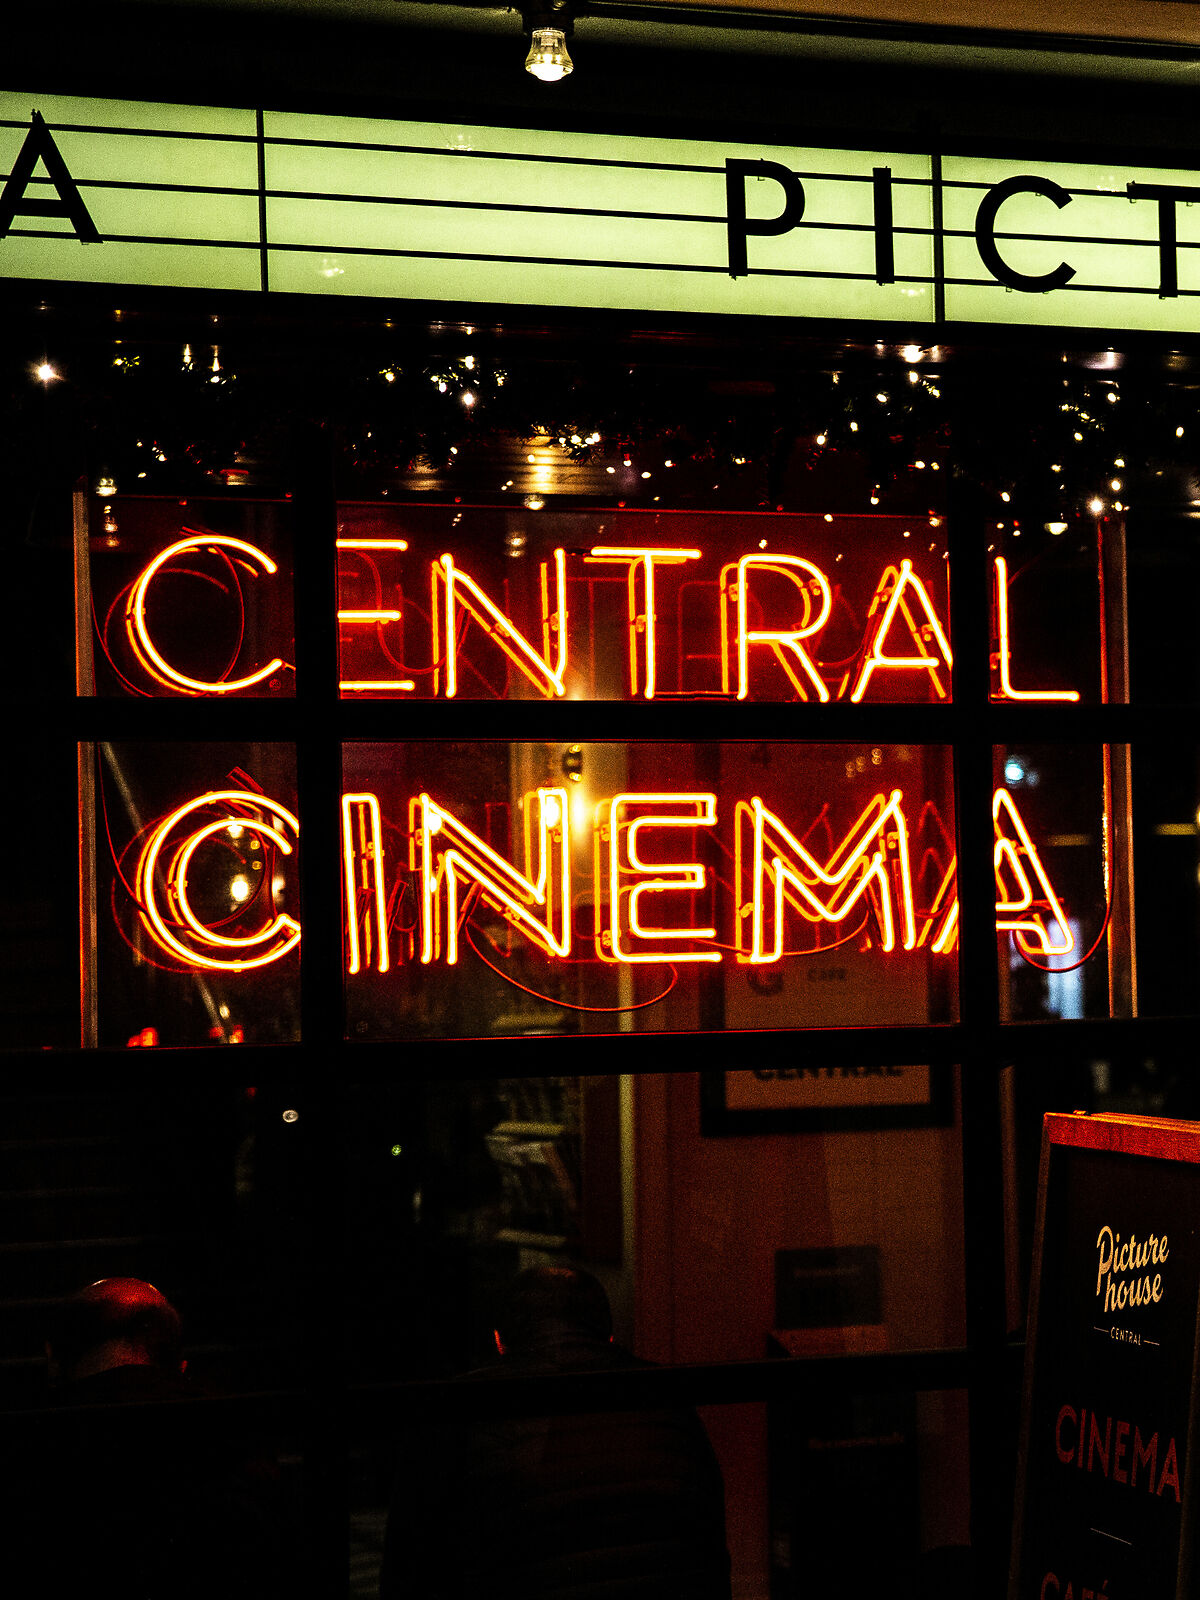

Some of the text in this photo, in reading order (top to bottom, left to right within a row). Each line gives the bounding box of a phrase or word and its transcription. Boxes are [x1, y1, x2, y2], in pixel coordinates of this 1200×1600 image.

[0, 109, 103, 244] A
[126, 533, 1081, 704] CENTRAL
[136, 787, 1077, 974] CINEMA
[1096, 1225, 1170, 1297] Picture
[1103, 1271, 1164, 1313] house
[1110, 1326, 1142, 1346] CENTRAL
[1054, 1403, 1182, 1503] CINEMA
